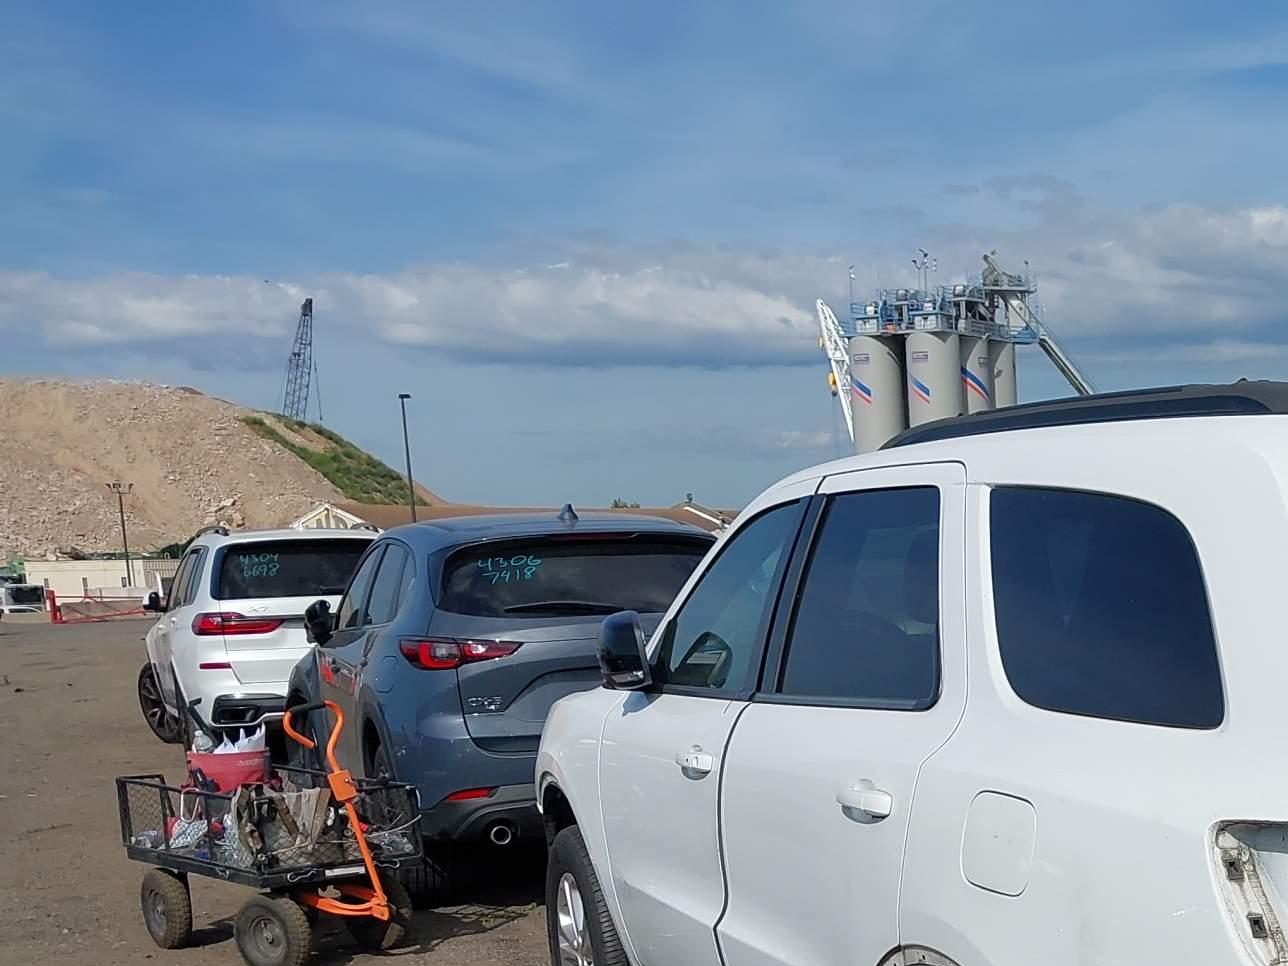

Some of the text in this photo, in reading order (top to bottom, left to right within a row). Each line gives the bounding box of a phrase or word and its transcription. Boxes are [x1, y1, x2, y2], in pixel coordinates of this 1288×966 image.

[239, 553, 279, 565] 4304
[478, 555, 541, 571] 4306
[243, 563, 280, 577] 6698
[482, 566, 536, 584] 7418
